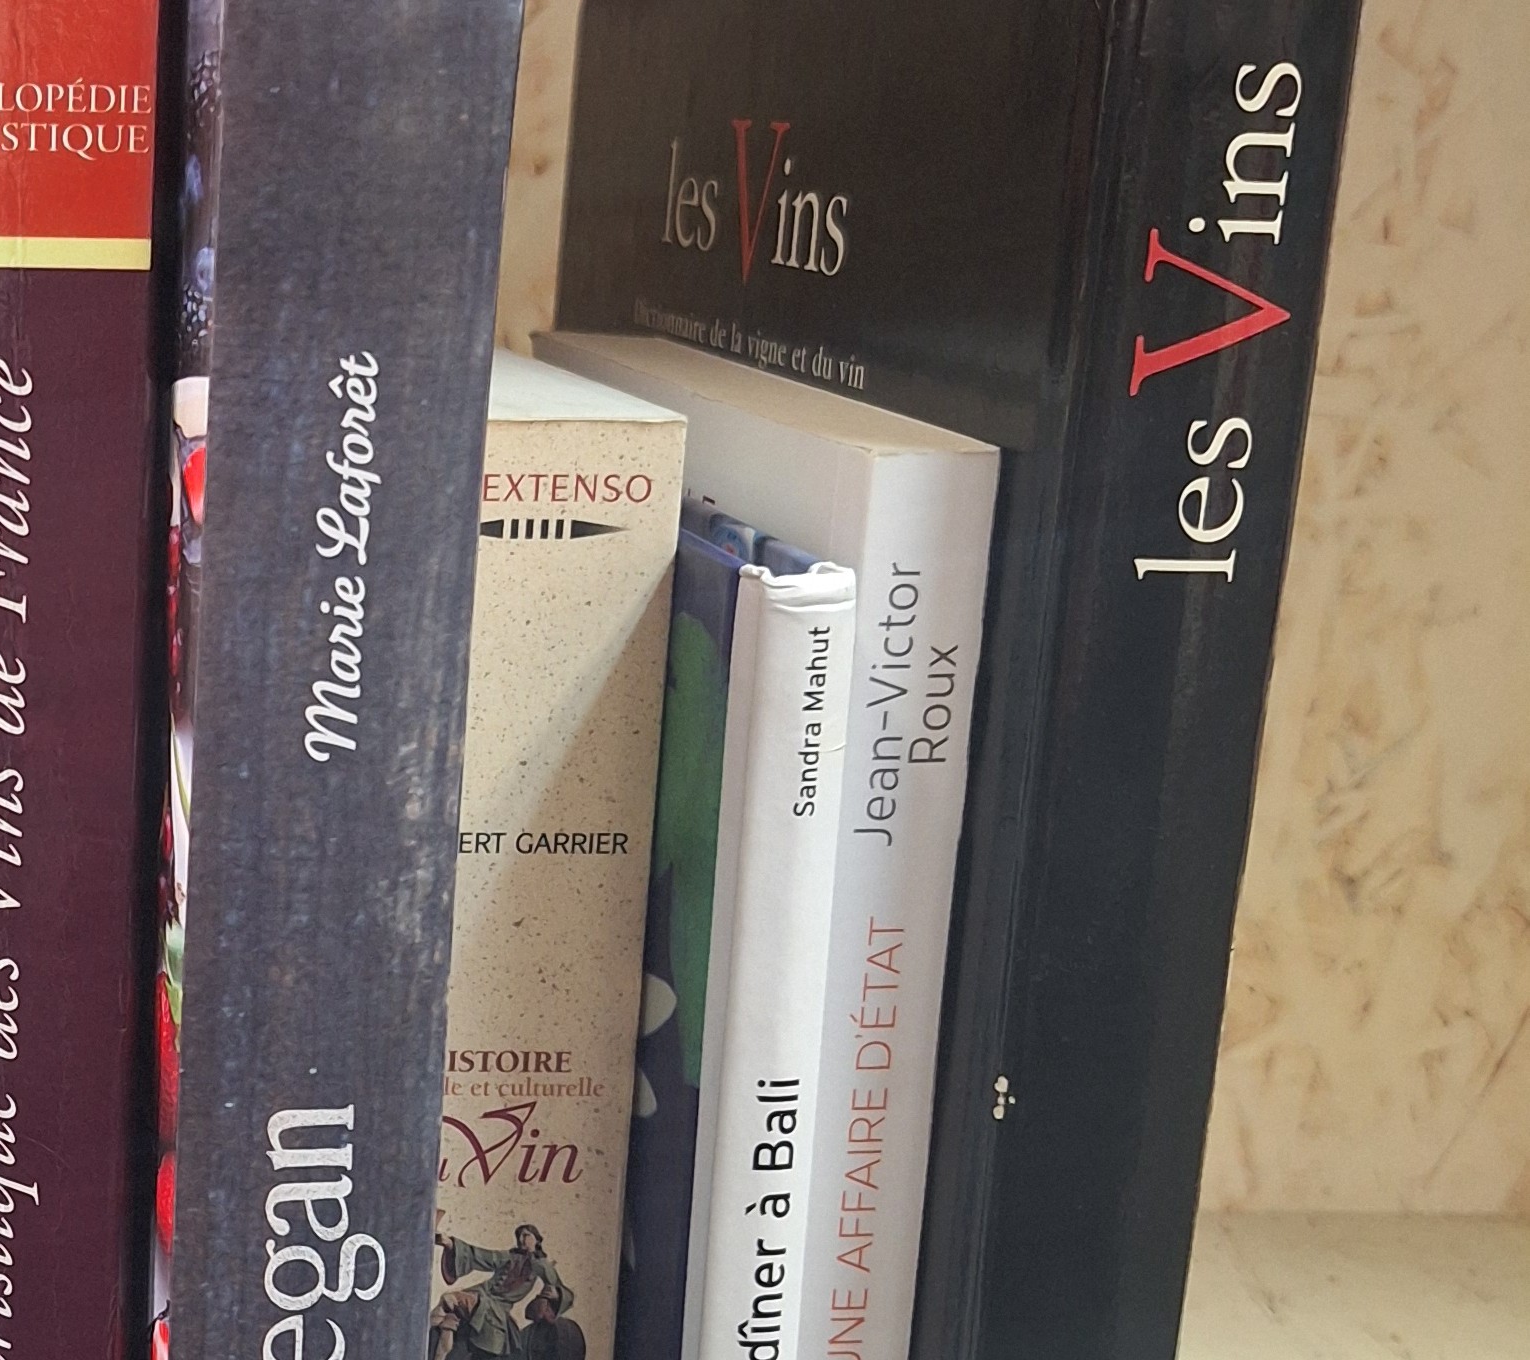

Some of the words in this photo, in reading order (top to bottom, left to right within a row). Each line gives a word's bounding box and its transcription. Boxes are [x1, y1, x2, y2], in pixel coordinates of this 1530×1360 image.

[662, 136, 719, 252] les
[731, 119, 849, 286] Vins
[1128, 60, 1304, 397] Vins
[709, 319, 726, 348] de
[730, 322, 742, 354] la
[748, 330, 786, 369] vigne
[792, 346, 806, 373] et
[811, 347, 832, 381] du
[839, 354, 865, 390] vin
[316, 350, 382, 565] Laforêt
[482, 474, 652, 502] EXTENSO
[1133, 415, 1254, 584] les
[305, 576, 365, 763] Marie
[802, 626, 831, 711] Mahut
[854, 562, 921, 846] Jean-Victor
[909, 644, 958, 763] Roux
[793, 722, 822, 818] Sandra
[458, 832, 506, 853] ERT
[515, 832, 628, 854] GARRIER
[850, 917, 904, 1071] D'ÉTAT
[448, 1050, 572, 1072] ISTOIRE
[470, 1081, 490, 1096] et
[497, 1077, 606, 1097] culturelle
[442, 1101, 584, 1188] Vin
[752, 1078, 800, 1171] Bali
[745, 1191, 791, 1219] à
[836, 1087, 889, 1273] AFFAIRE
